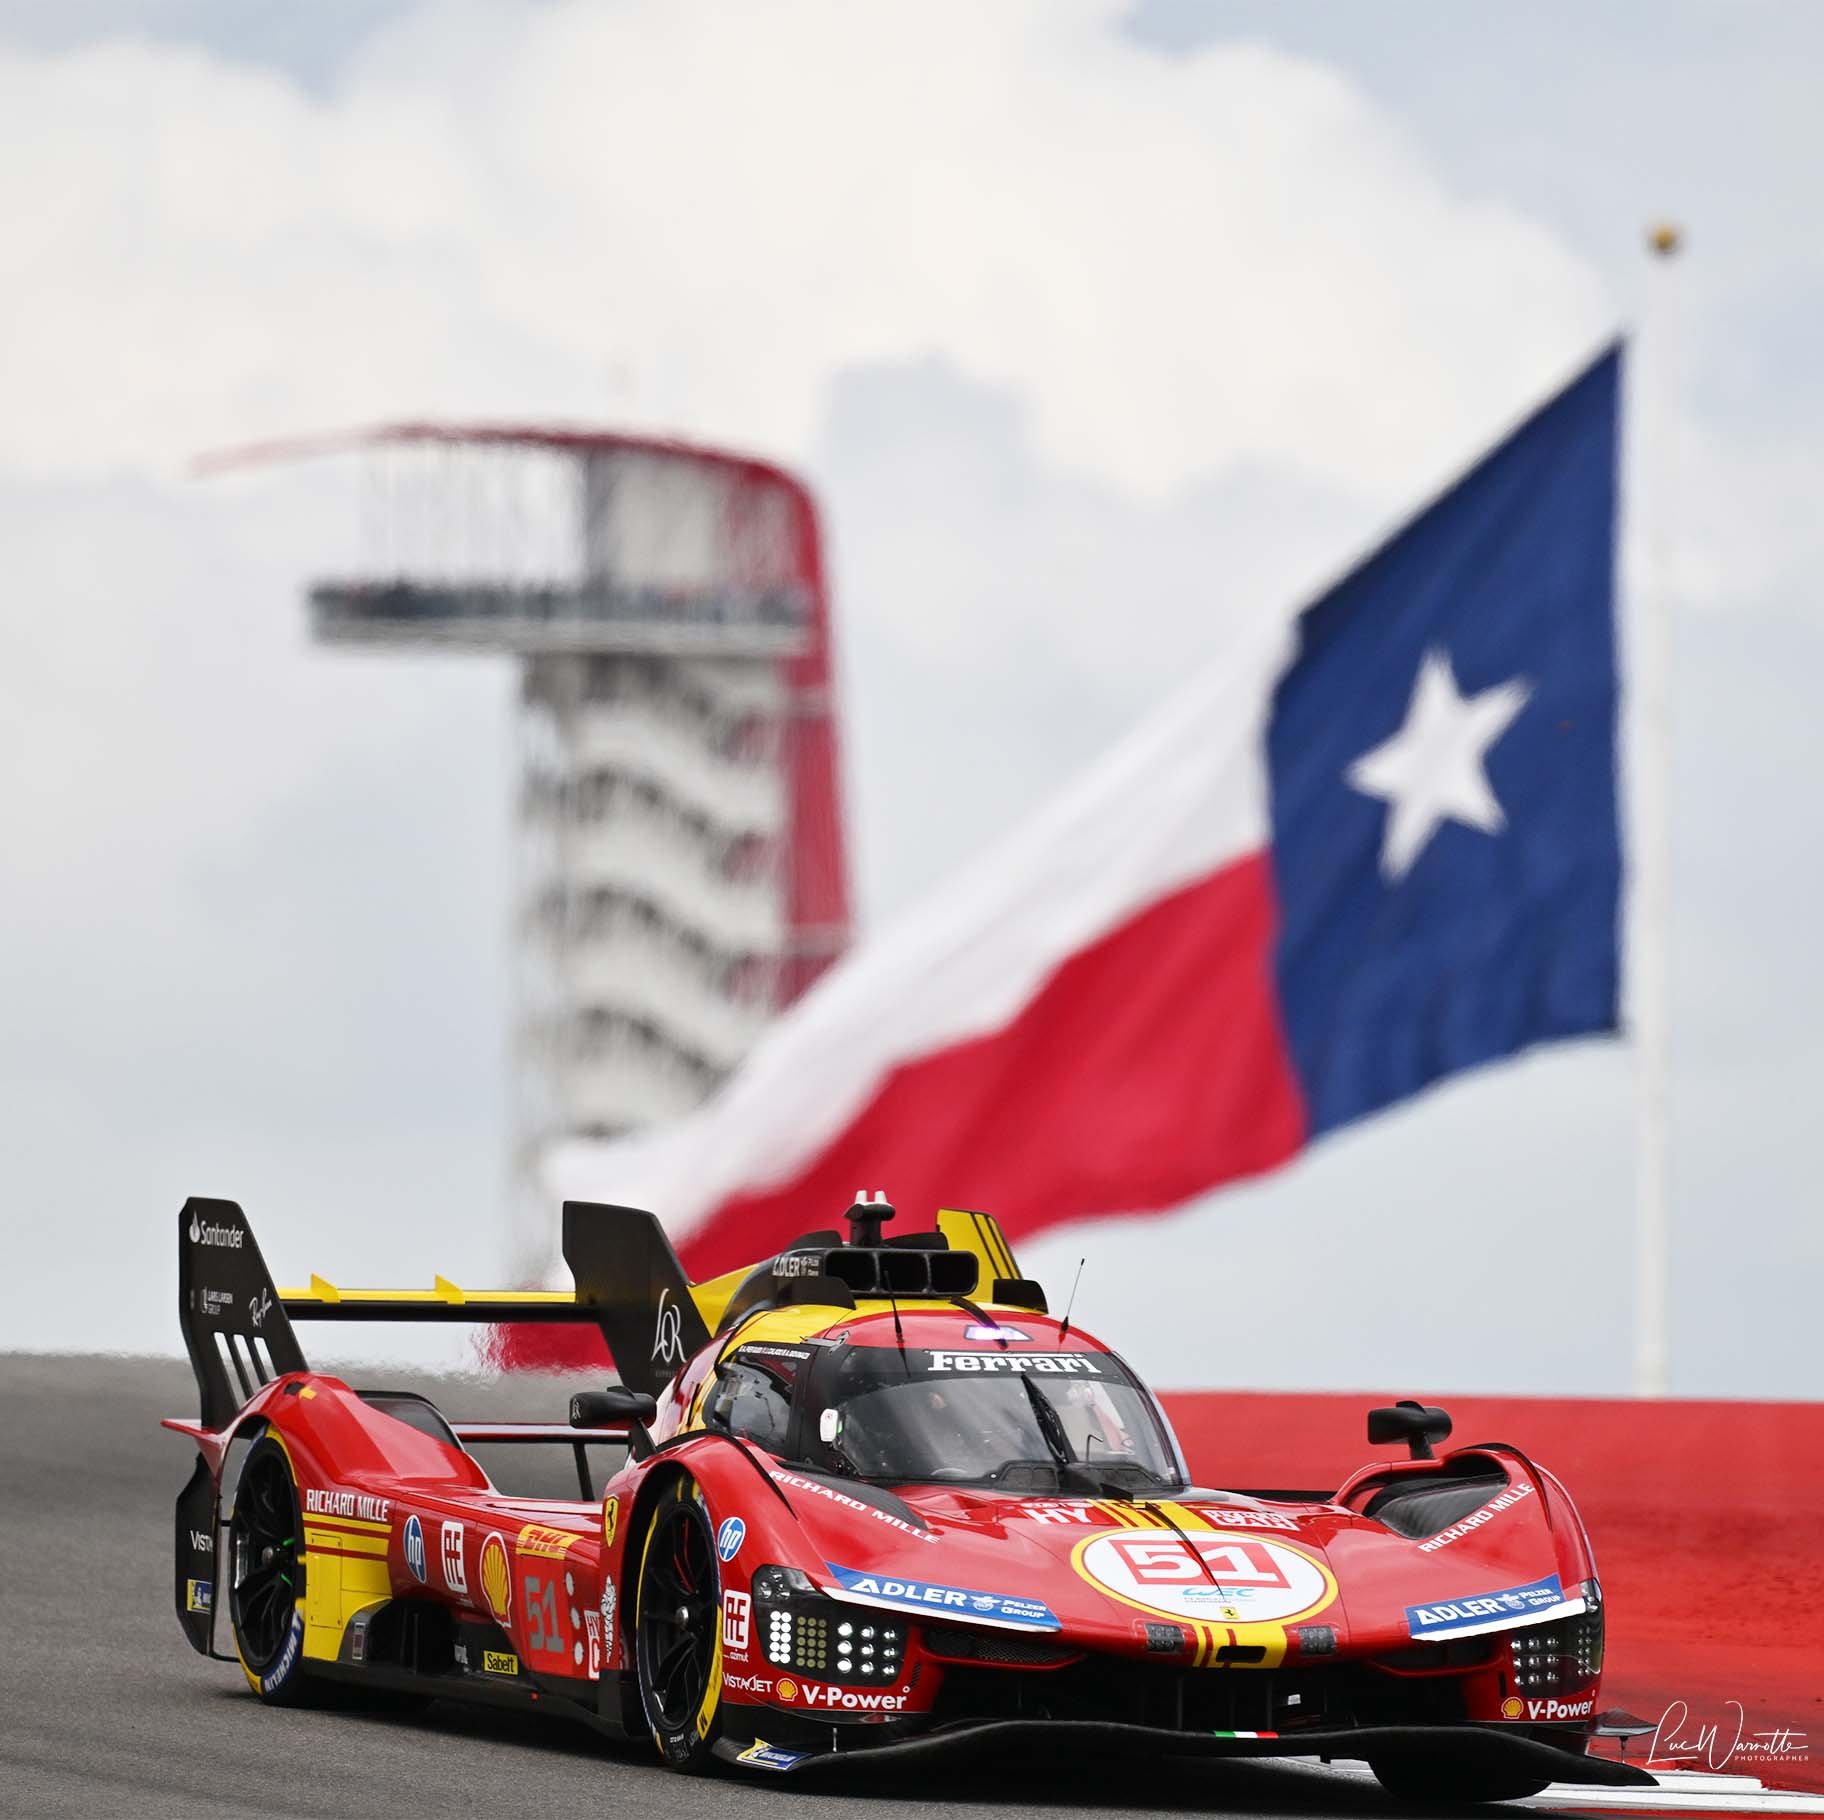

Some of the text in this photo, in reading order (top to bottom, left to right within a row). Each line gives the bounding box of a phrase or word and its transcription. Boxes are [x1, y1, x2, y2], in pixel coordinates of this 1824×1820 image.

[200, 1220, 243, 1248] Santander
[926, 1351, 1102, 1374] Ferrari
[306, 1489, 390, 1522] RICHARD MILLE
[768, 1470, 942, 1544] RICHARD MILLE
[1417, 1482, 1536, 1553] RICHARD MILLE
[408, 1517, 424, 1582] hp
[719, 1519, 744, 1561] hp
[1126, 1543, 1281, 1583] 51
[850, 1578, 968, 1607] ADLER
[1003, 1600, 1047, 1612] PELZER
[1520, 1587, 1554, 1600] PELZER
[1528, 1594, 1561, 1607] GROUP
[524, 1575, 565, 1654] 51
[1001, 1606, 1046, 1618] GROUP
[1416, 1597, 1504, 1625] ADLER
[264, 1631, 298, 1692] MICHELIN
[487, 1653, 514, 1673] Sabelt
[722, 1672, 773, 1693] VISTAJET
[802, 1684, 907, 1710] V-Power
[1527, 1698, 1594, 1720] V-Power
